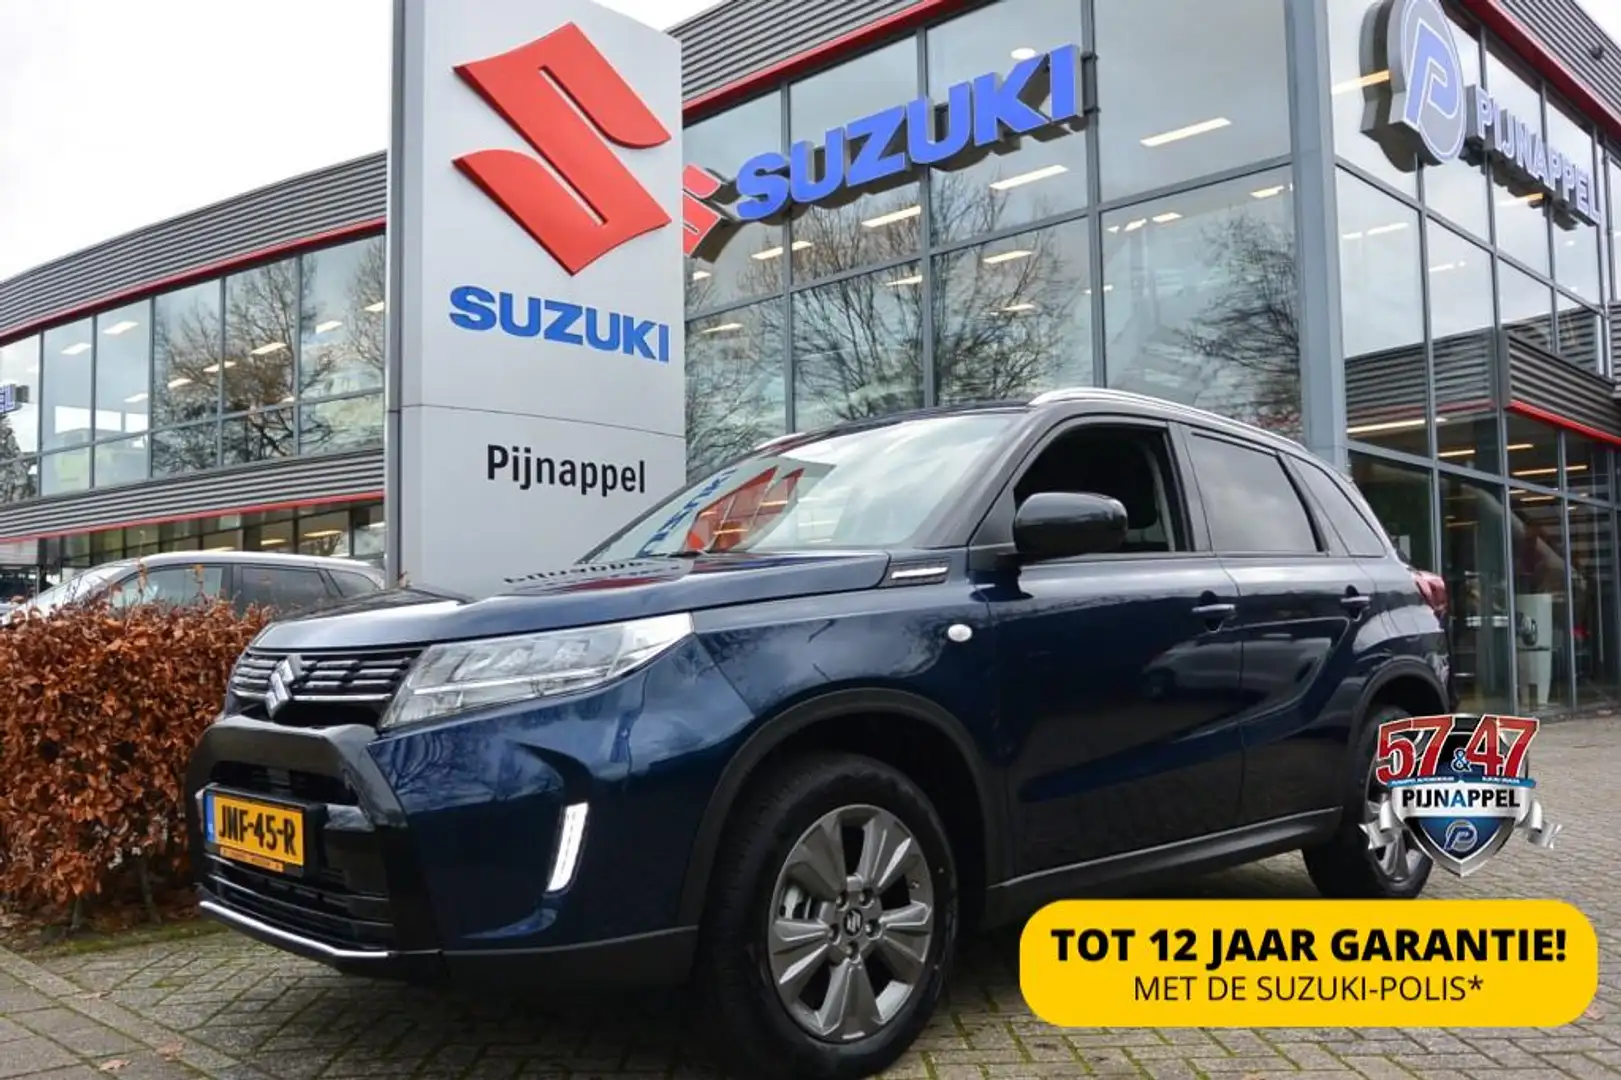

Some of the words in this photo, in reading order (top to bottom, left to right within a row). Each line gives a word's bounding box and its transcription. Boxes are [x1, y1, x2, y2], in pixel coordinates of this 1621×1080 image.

[735, 44, 1080, 221] SUZUKI
[1474, 85, 1605, 226] PIJNAPPEL
[449, 285, 670, 363] SUZUKI
[487, 444, 646, 498] Pijnappel
[219, 804, 297, 857] JNF-45-R
